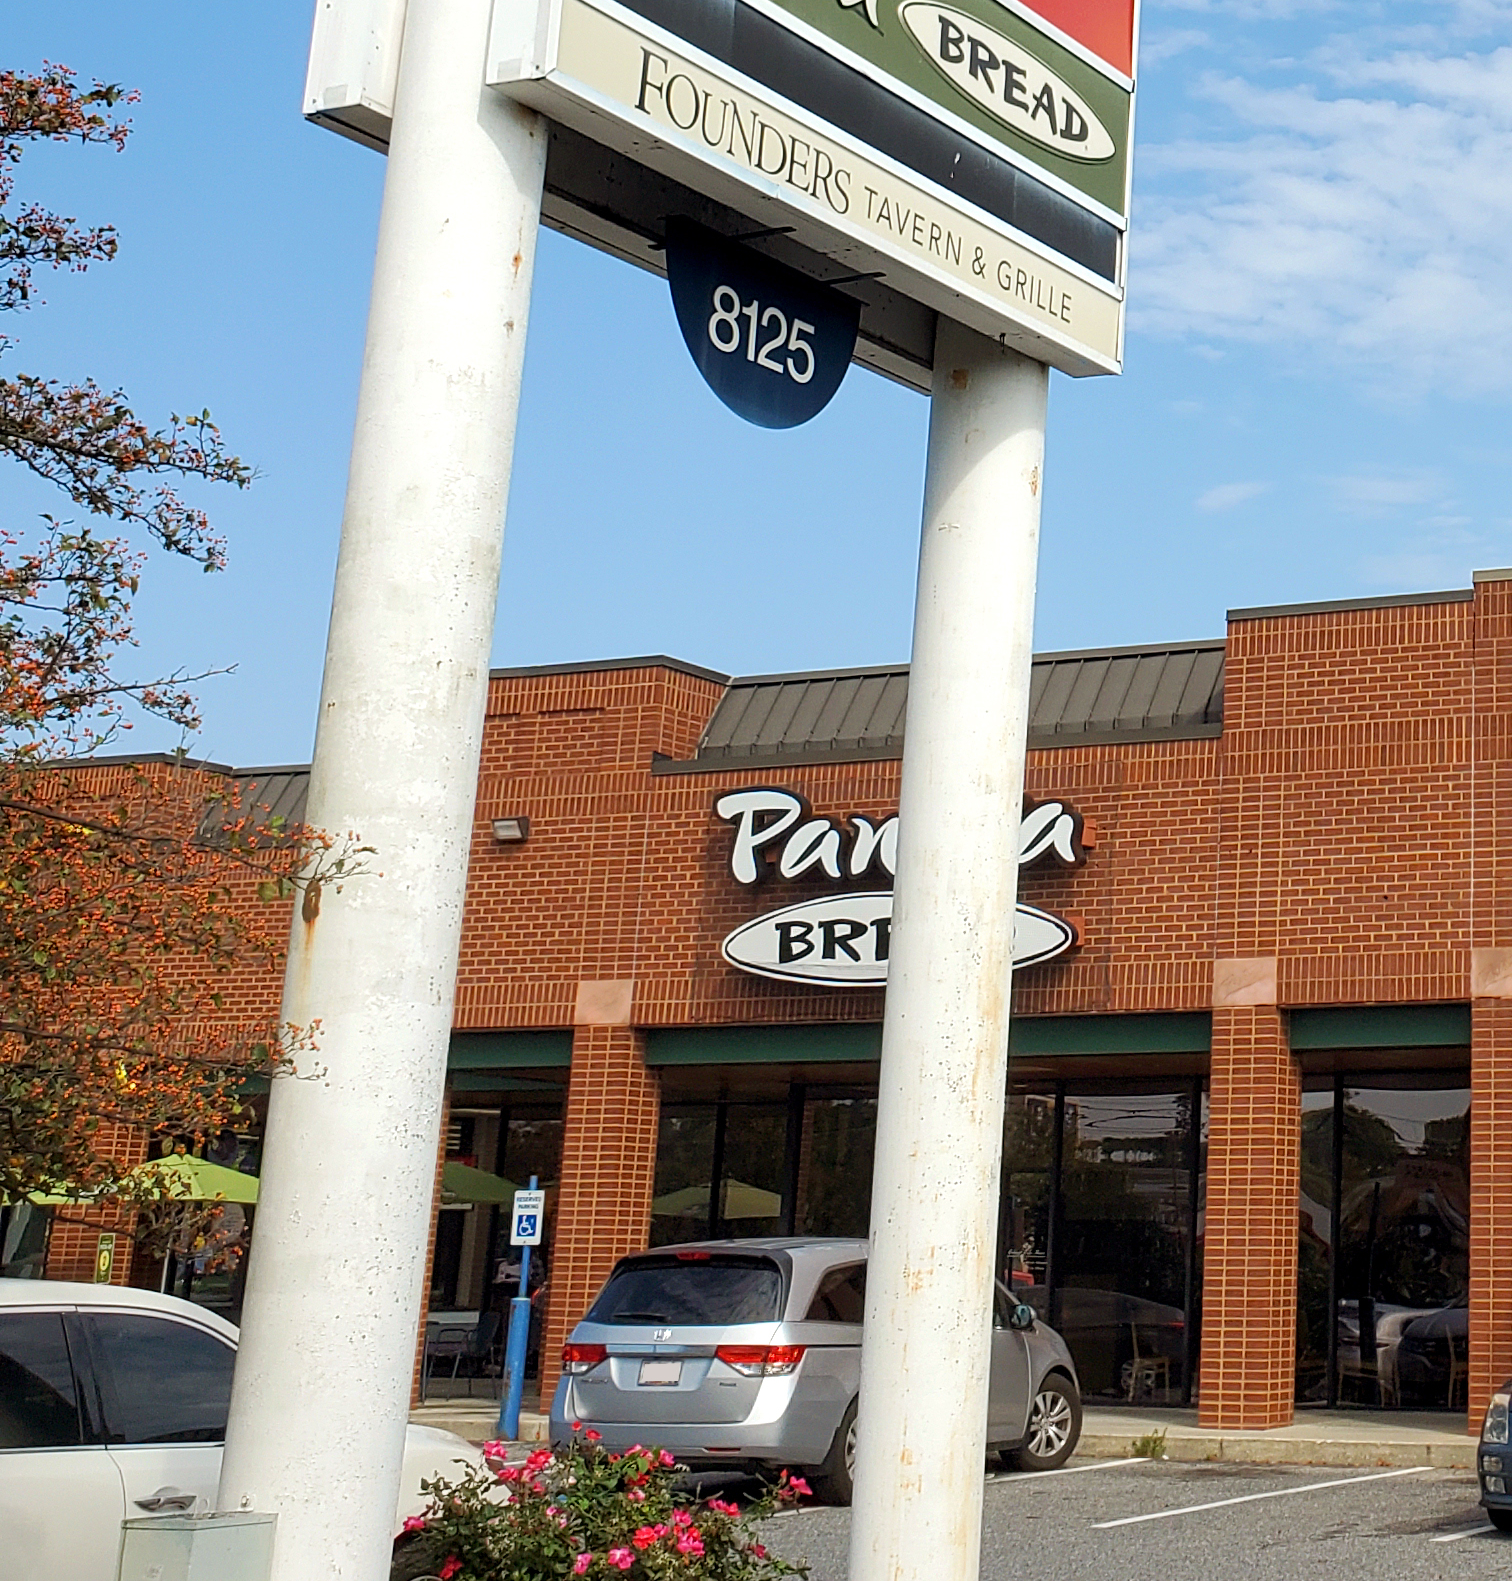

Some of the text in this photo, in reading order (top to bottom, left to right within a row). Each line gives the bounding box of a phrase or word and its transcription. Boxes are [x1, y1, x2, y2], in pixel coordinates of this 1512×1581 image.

[938, 15, 1089, 142] BREAD
[634, 45, 1073, 324] FOUNDERS TAVERN & GRILLE
[707, 284, 816, 385] 8125
[716, 789, 1076, 884] Pana
